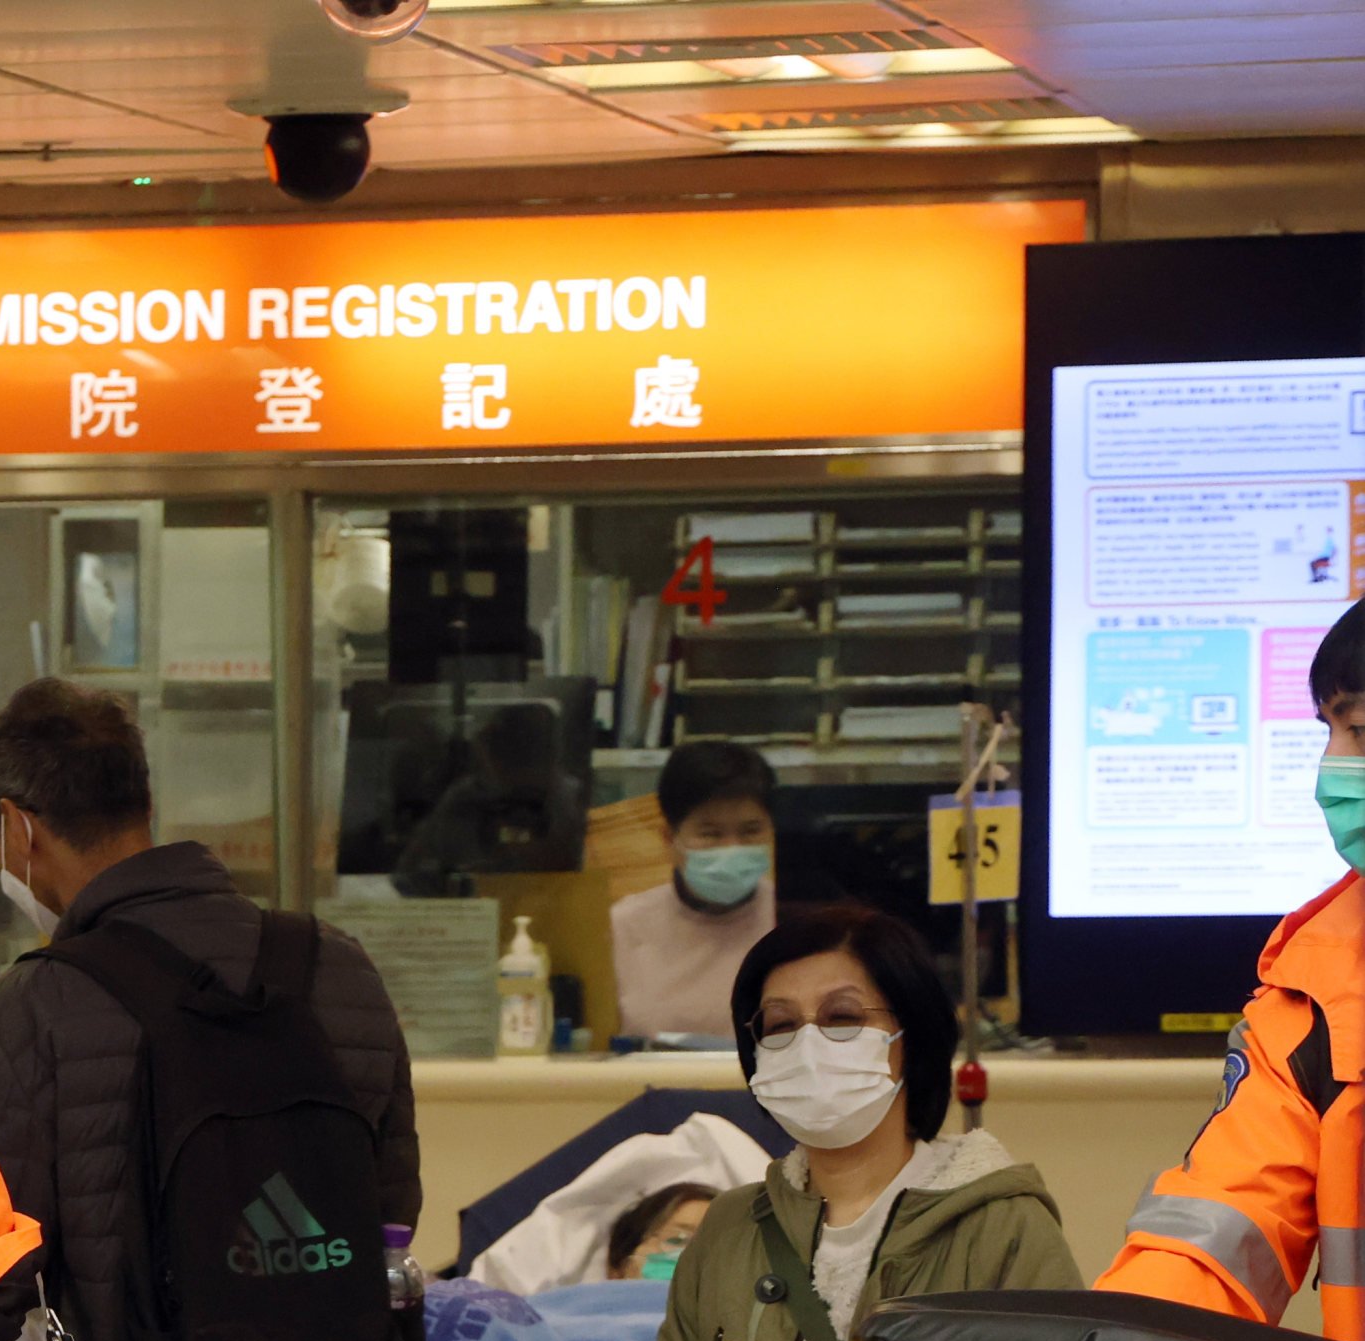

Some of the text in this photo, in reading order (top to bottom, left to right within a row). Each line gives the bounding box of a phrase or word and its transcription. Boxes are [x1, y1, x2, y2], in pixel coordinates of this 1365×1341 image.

[247, 275, 706, 339] REGISTRATION
[661, 536, 727, 625] 4
[227, 1234, 353, 1277] adidas
